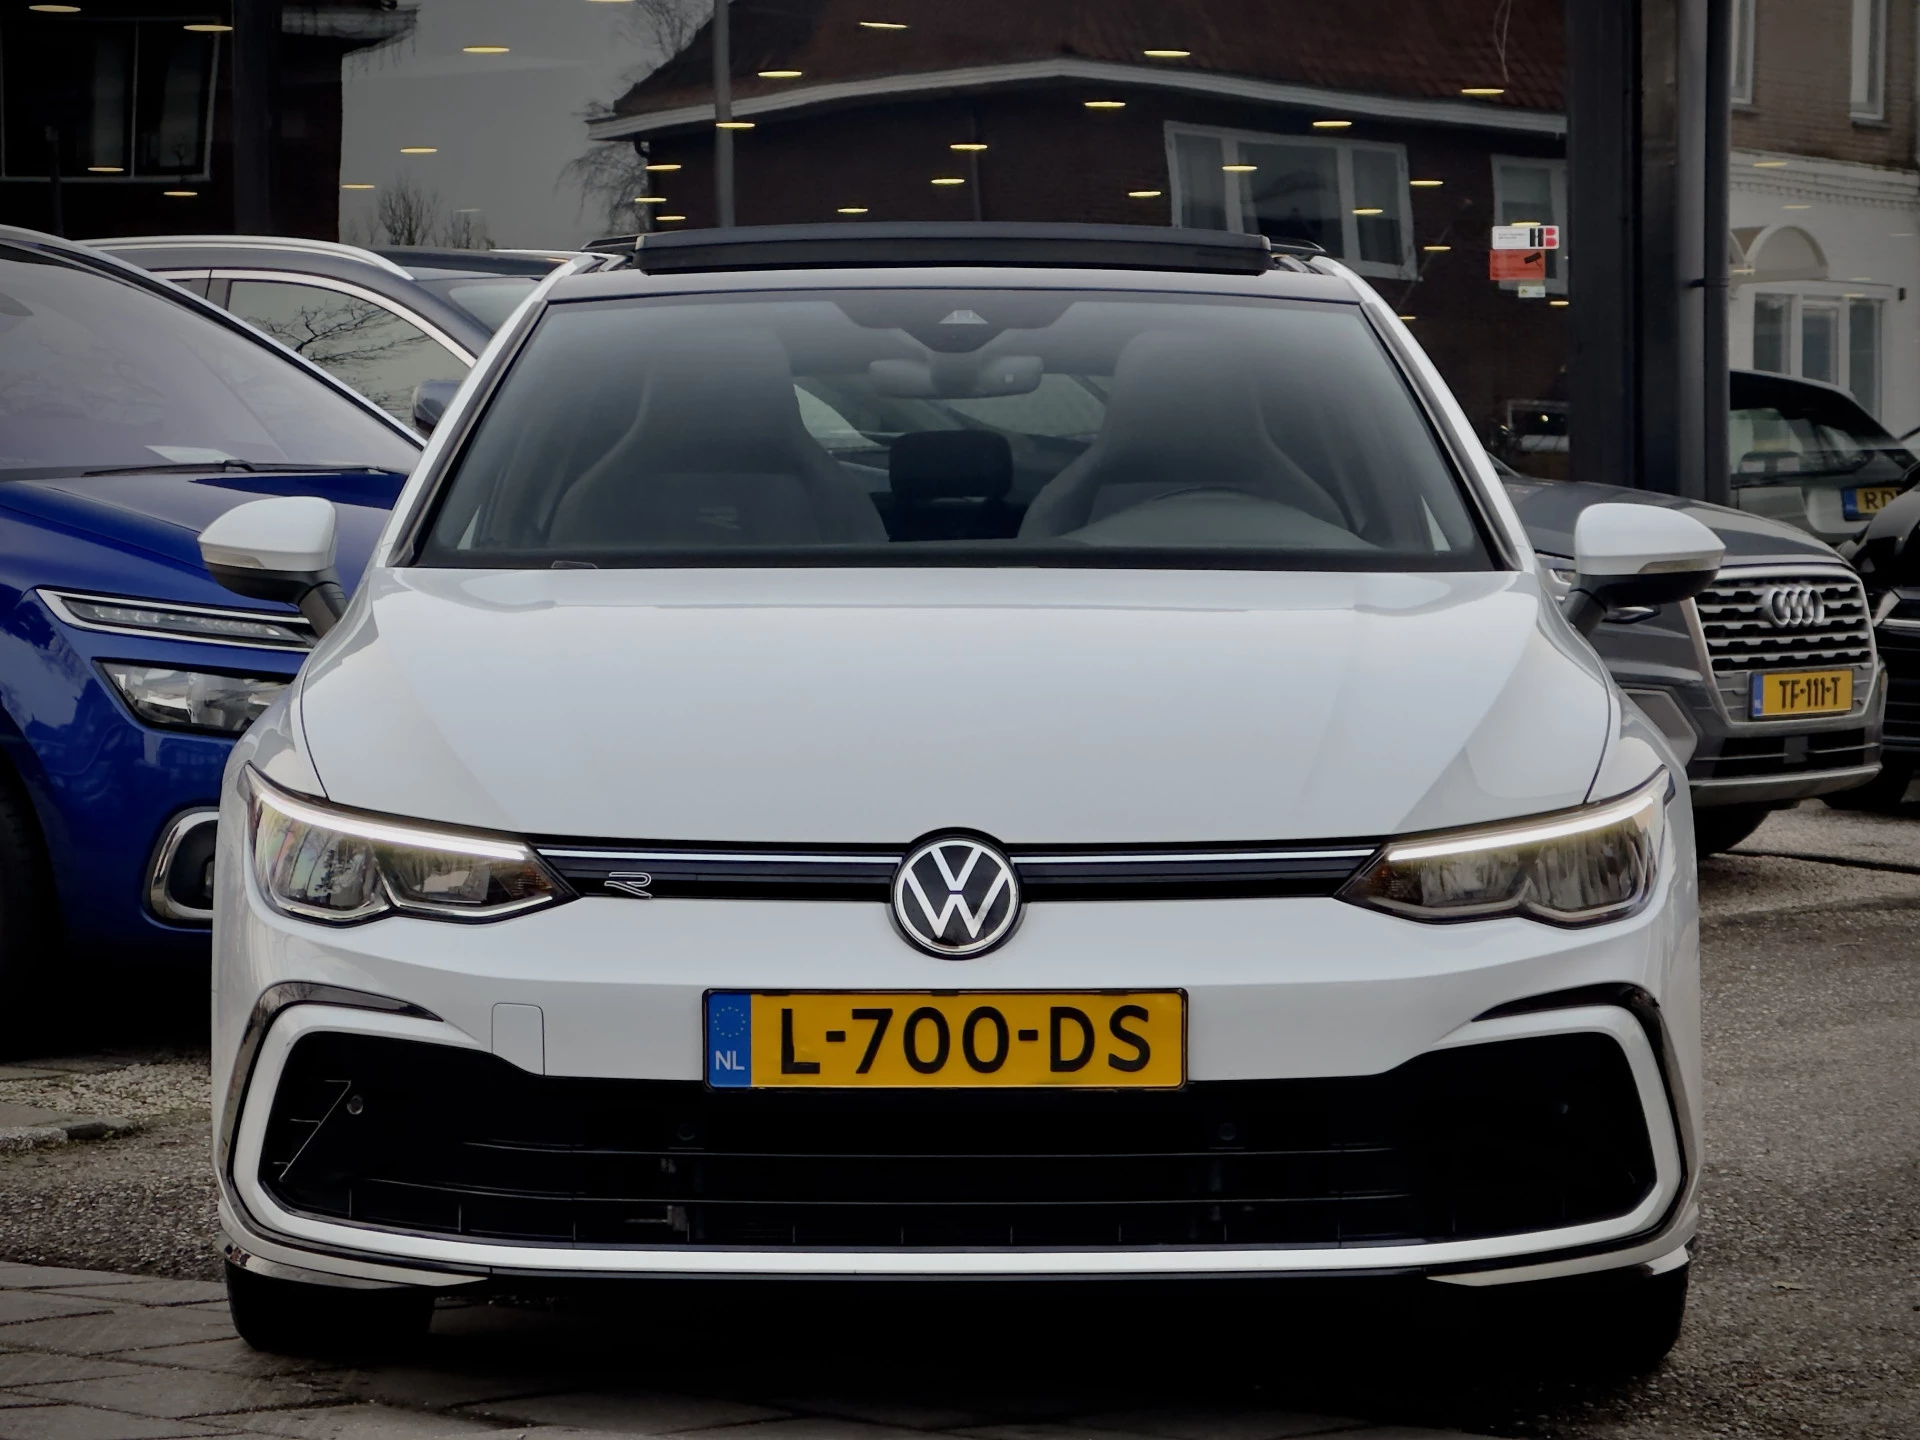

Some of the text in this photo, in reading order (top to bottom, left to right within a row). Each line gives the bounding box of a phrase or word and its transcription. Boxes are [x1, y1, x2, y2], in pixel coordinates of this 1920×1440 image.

[1779, 677, 1841, 709] TF-111-T
[715, 1004, 1151, 1074] NL L-700-DS
